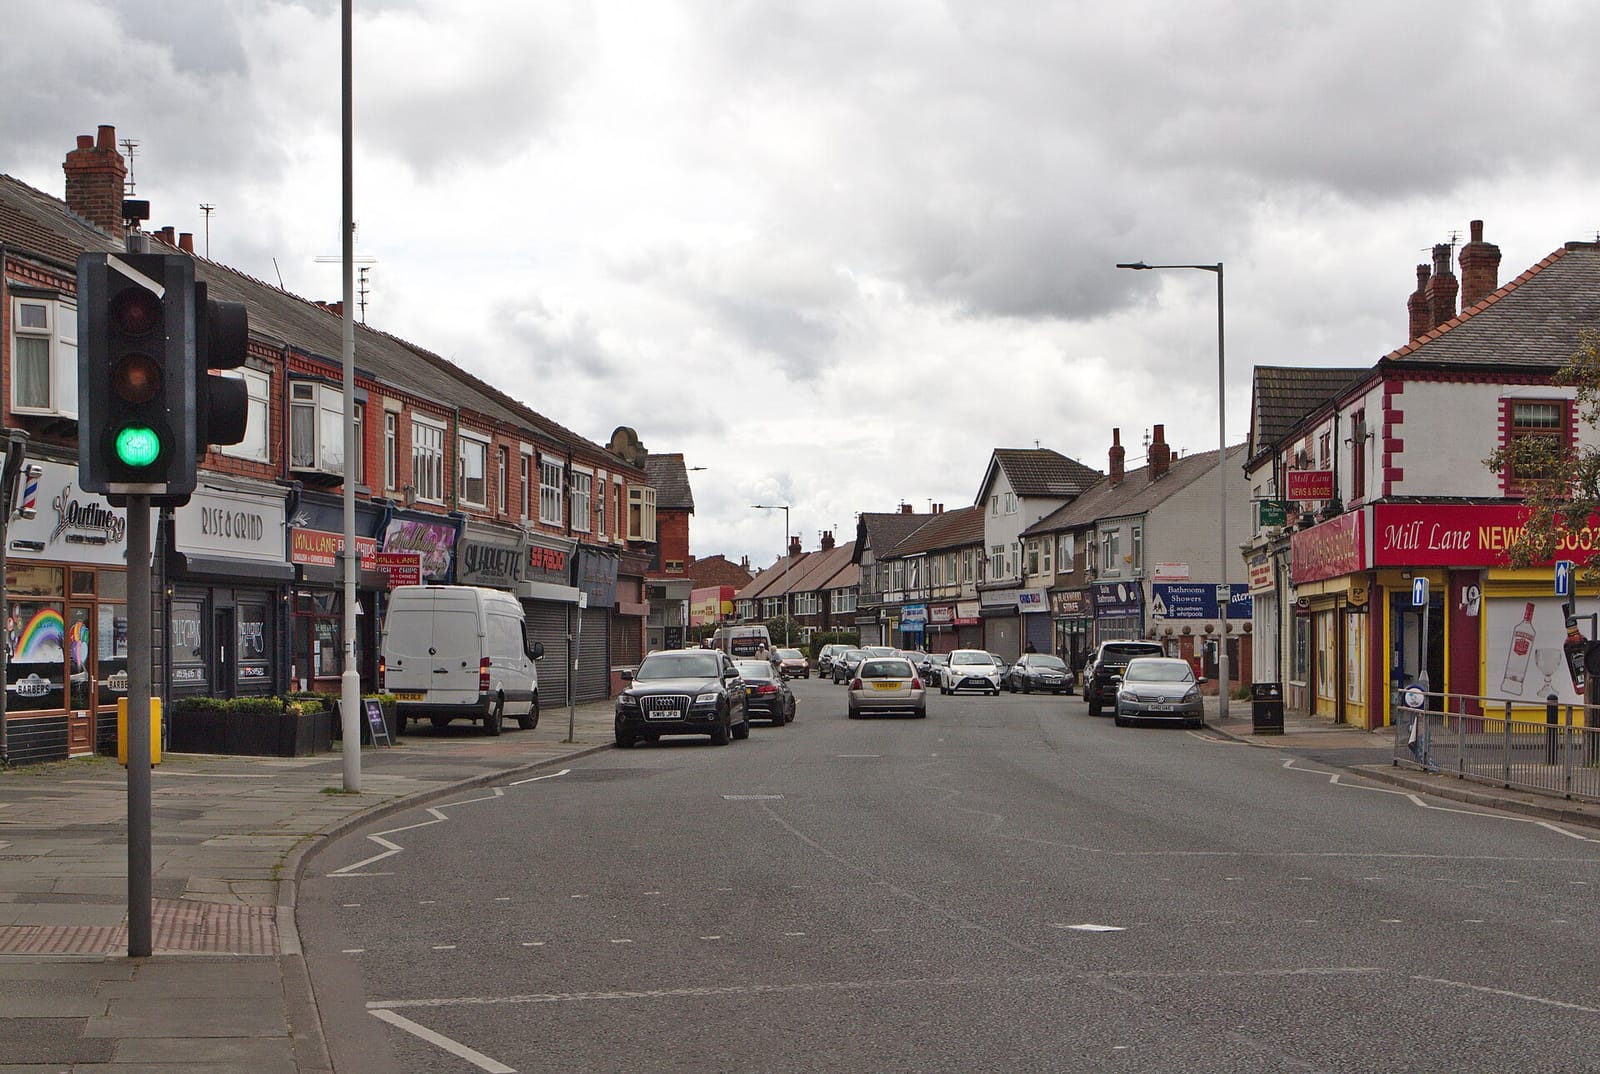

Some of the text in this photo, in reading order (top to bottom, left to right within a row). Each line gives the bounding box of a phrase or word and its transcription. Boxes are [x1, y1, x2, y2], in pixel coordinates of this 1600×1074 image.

[1291, 487, 1307, 497] NEWS
[1312, 486, 1331, 496] BOOZE
[68, 500, 115, 529] Outline
[201, 506, 224, 537] RISE
[233, 512, 264, 542] GRIND
[1384, 520, 1424, 551] Mill
[1427, 522, 1471, 551] Lane
[295, 533, 315, 552] MILL
[315, 537, 336, 554] LANE
[396, 556, 418, 565] LANE
[463, 543, 523, 582] SILHOUETTE
[1168, 586, 1205, 594] Bathrooms
[1171, 594, 1202, 603] Showers
[17, 684, 50, 694] BARBERS
[109, 680, 128, 689] BARBE
